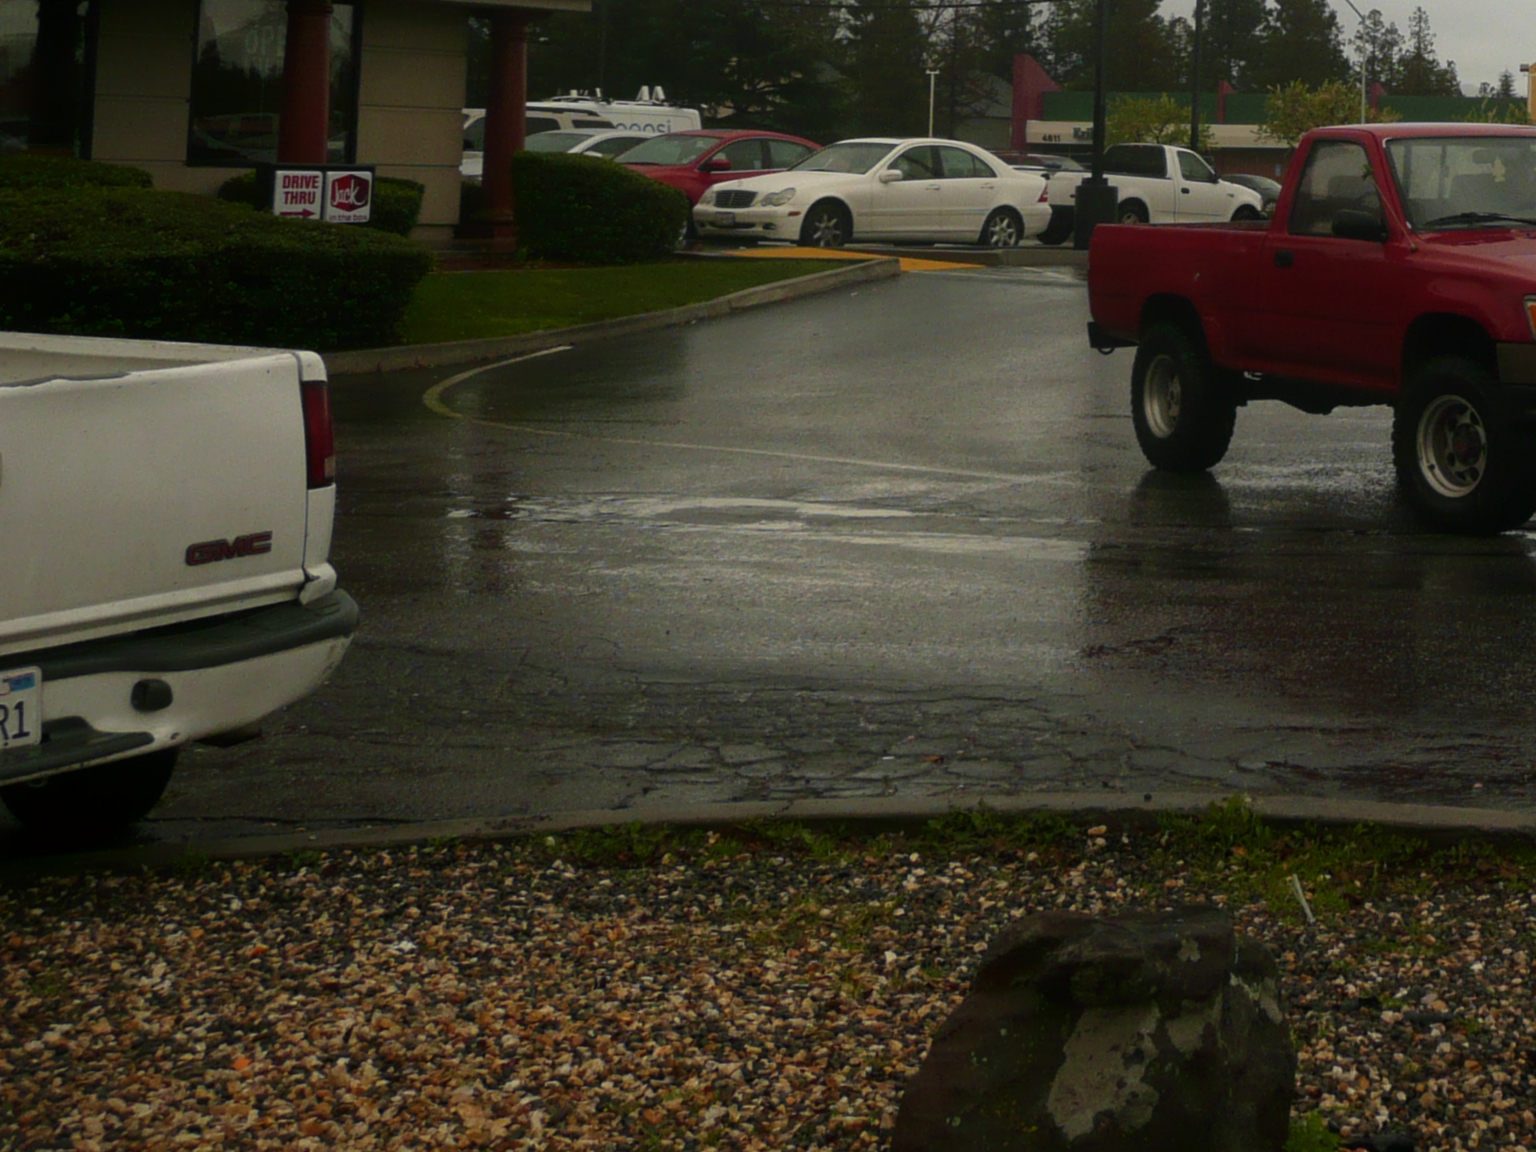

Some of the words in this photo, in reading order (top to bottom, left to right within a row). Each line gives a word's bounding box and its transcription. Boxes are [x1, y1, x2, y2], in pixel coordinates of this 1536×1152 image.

[282, 175, 320, 189] DRIVE
[332, 178, 368, 207] Jack
[284, 191, 317, 205] THRU
[185, 530, 273, 567] GMC
